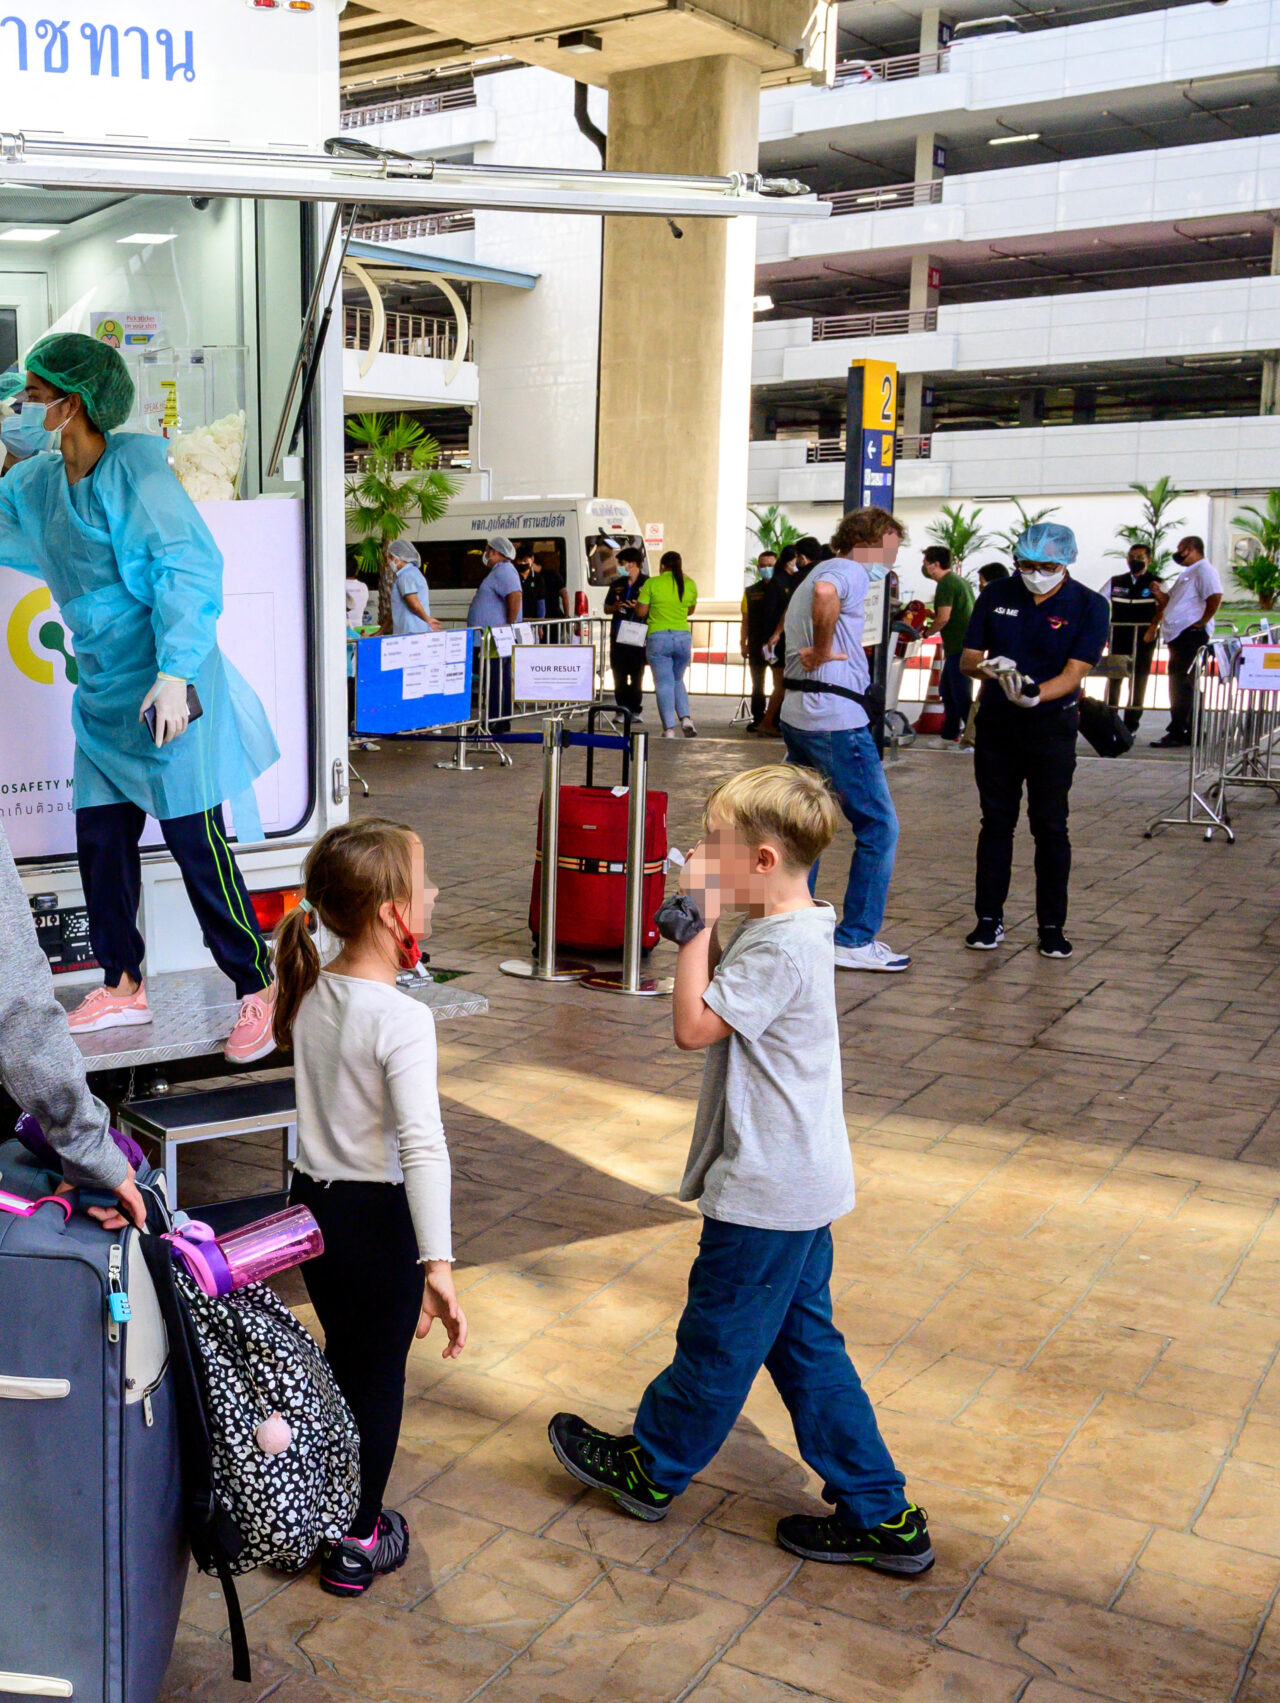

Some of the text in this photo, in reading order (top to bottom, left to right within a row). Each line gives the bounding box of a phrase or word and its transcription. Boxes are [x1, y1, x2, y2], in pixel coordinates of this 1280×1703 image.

[880, 374, 893, 422] 2
[1006, 608, 1020, 617] ME
[530, 665, 581, 673] YOUR RESULT
